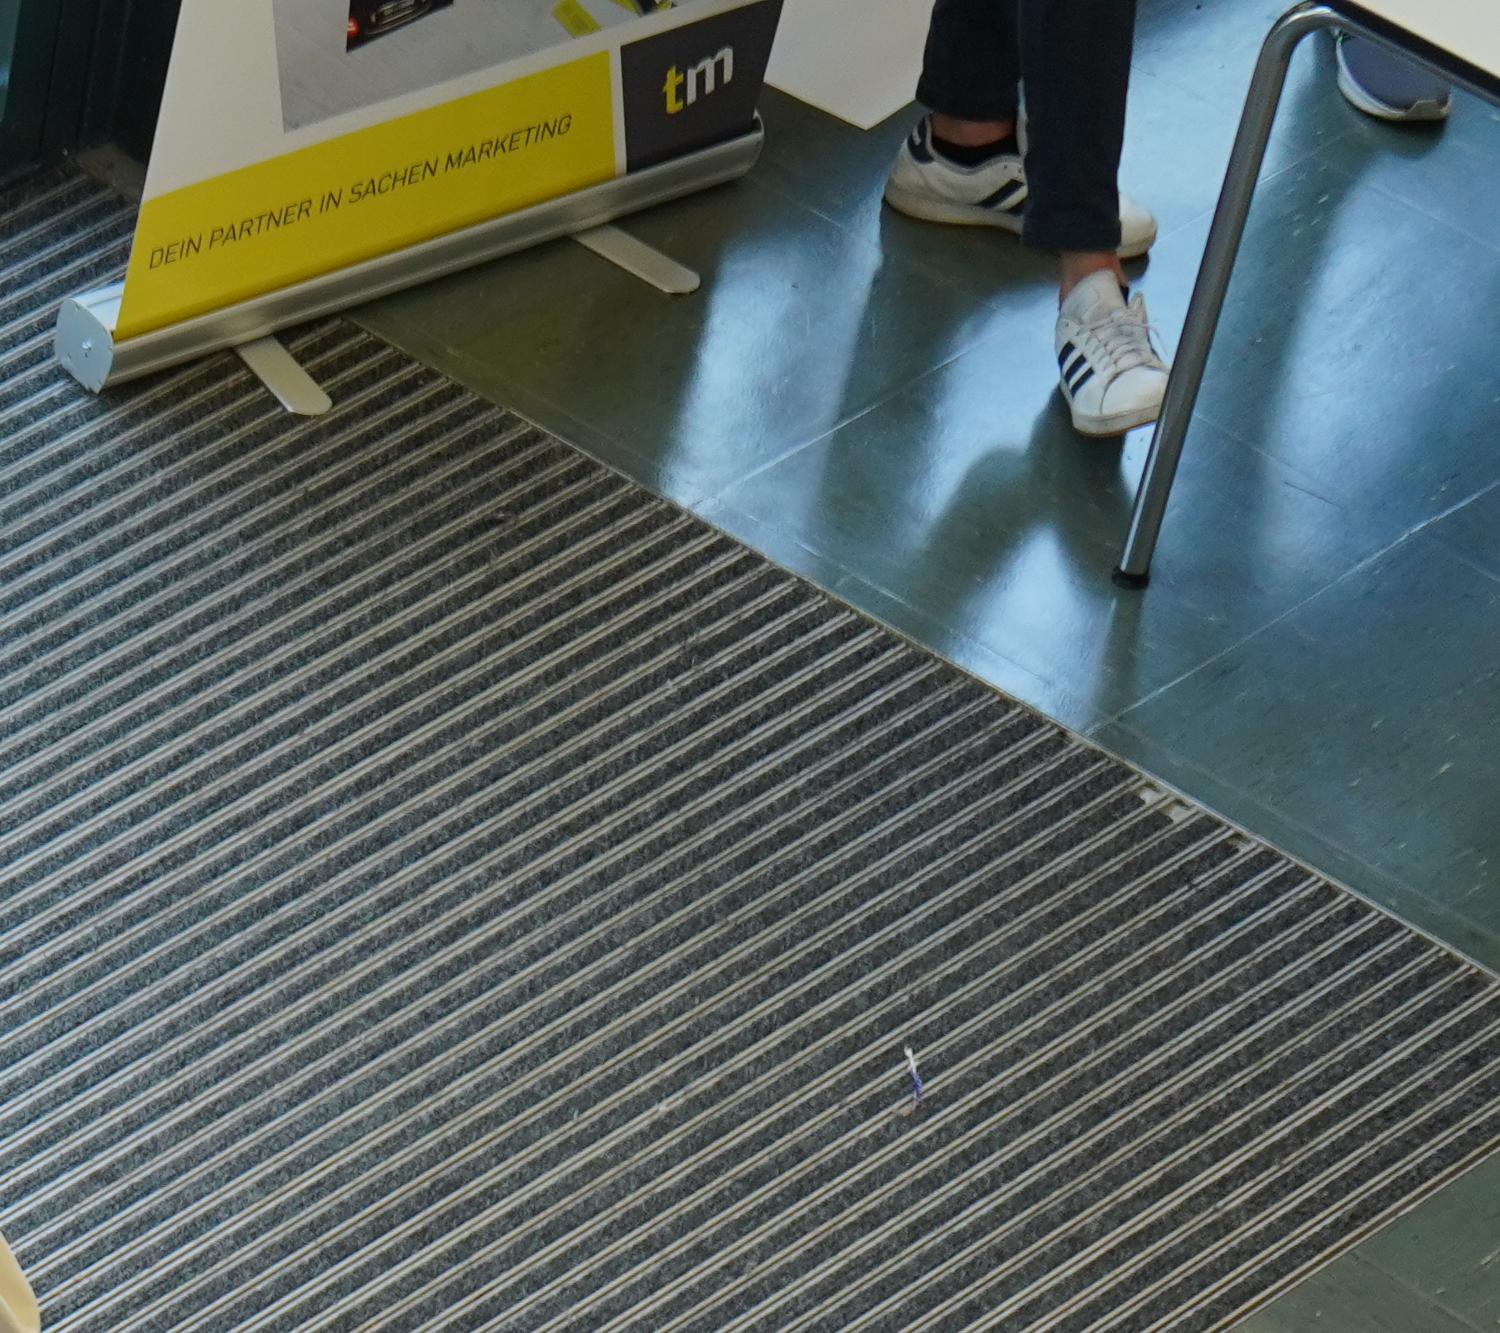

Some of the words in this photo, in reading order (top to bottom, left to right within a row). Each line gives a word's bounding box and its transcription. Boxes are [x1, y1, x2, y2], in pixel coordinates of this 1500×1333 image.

[661, 44, 736, 116] tm
[148, 234, 202, 271] DEIN
[208, 200, 313, 254] PARTNER
[318, 187, 345, 216] IN
[348, 157, 441, 205] SACHEN
[443, 113, 573, 176] MARKETING
